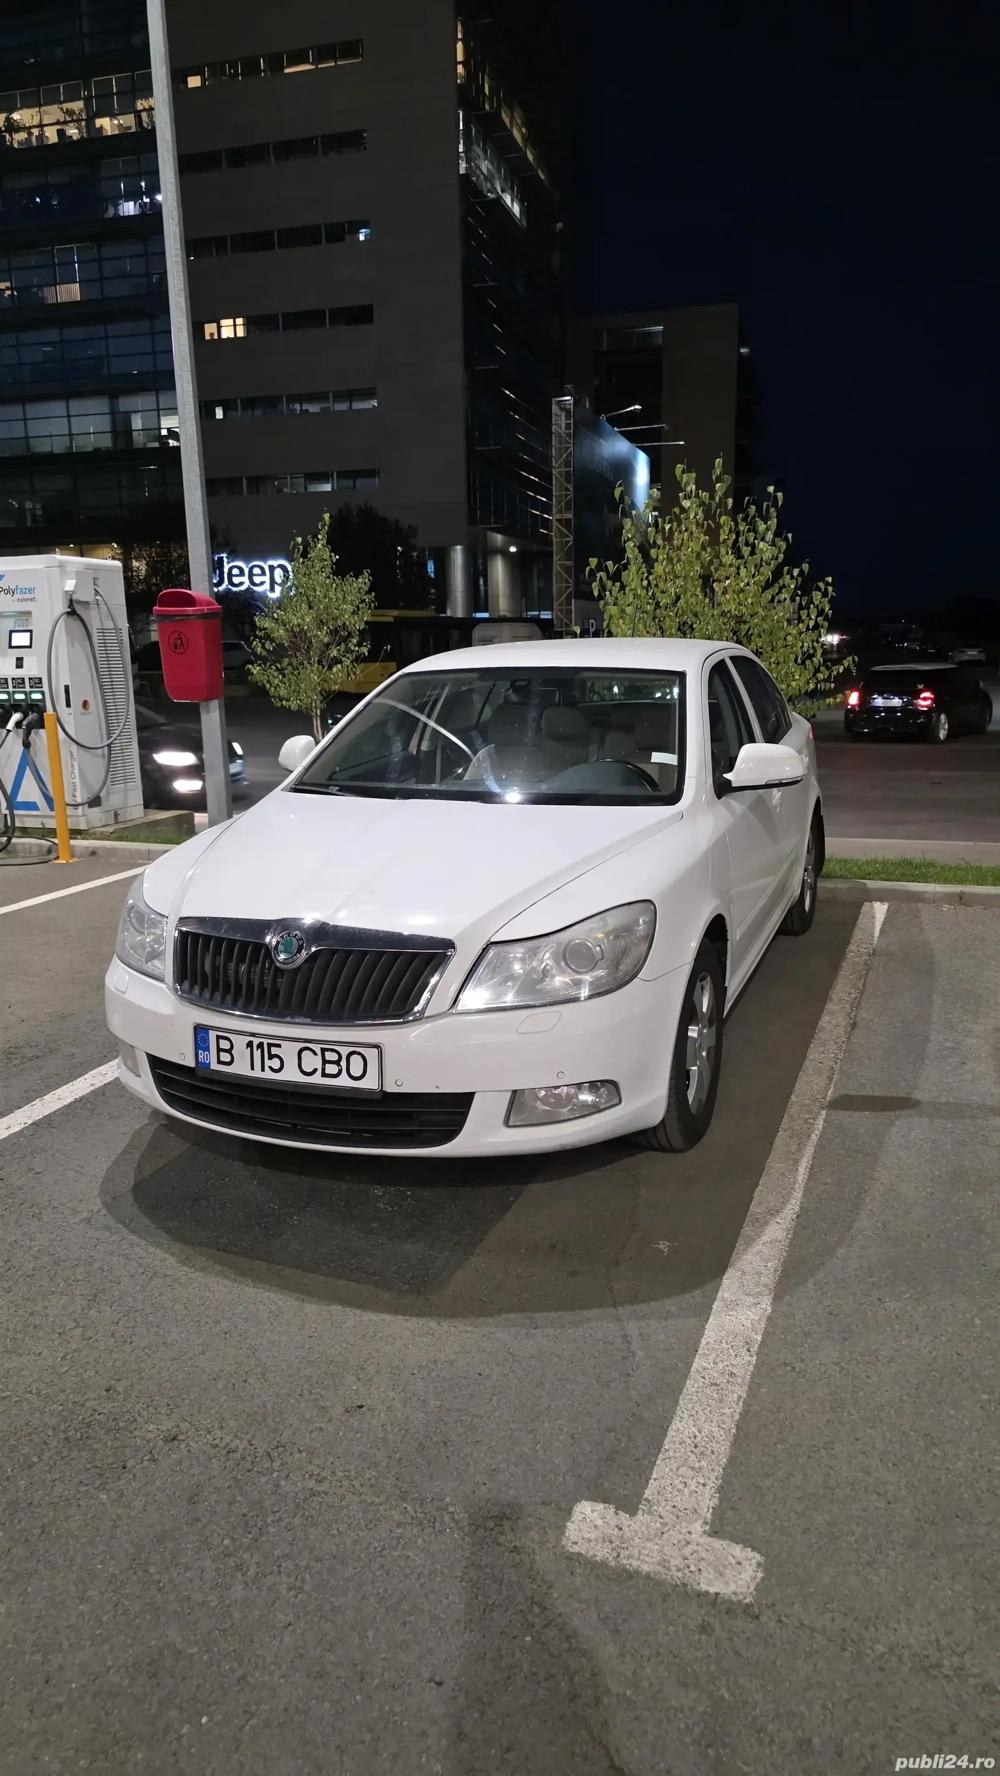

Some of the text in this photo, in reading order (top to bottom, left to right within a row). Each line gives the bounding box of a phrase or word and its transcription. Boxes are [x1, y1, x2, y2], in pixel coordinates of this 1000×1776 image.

[213, 555, 291, 596] Jeep
[0, 584, 36, 597] Polyfazer
[590, 618, 596, 638] P
[69, 750, 77, 780] Charger
[198, 1050, 210, 1063] RO
[215, 1034, 368, 1081] B 115 CBO
